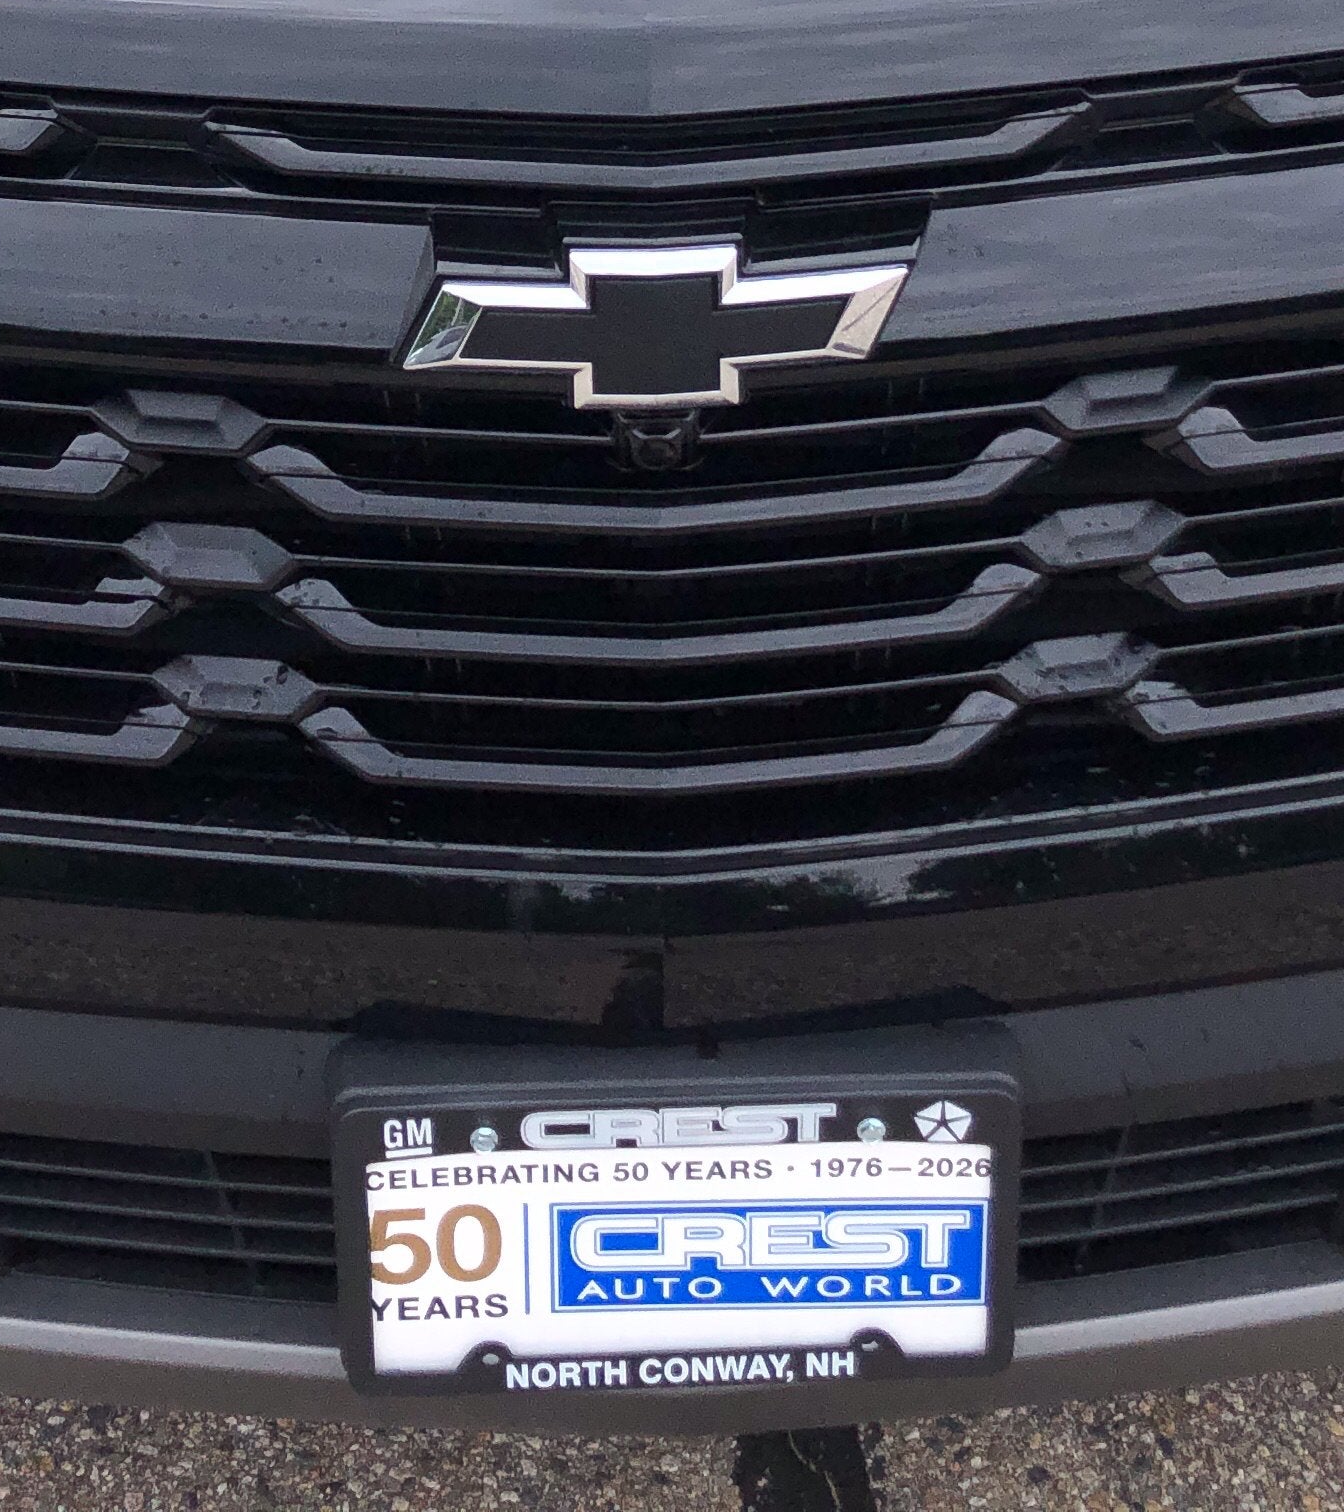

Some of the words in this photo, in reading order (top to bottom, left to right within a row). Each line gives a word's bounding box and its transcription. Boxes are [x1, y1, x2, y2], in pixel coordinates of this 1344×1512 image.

[384, 1118, 433, 1149] GM
[520, 1103, 837, 1149] CREST
[365, 1163, 599, 1191] CELEBRATING
[612, 1162, 650, 1182] 50
[661, 1160, 773, 1182] YEARS
[369, 1203, 503, 1286] 50
[569, 1209, 971, 1272] CREST
[576, 1276, 723, 1300] AUTO
[760, 1273, 963, 1298] WORLD
[370, 1294, 509, 1321] YEARS
[506, 1360, 627, 1389] NORTH
[639, 1353, 794, 1383] CONWAY,
[805, 1351, 855, 1378] NH
